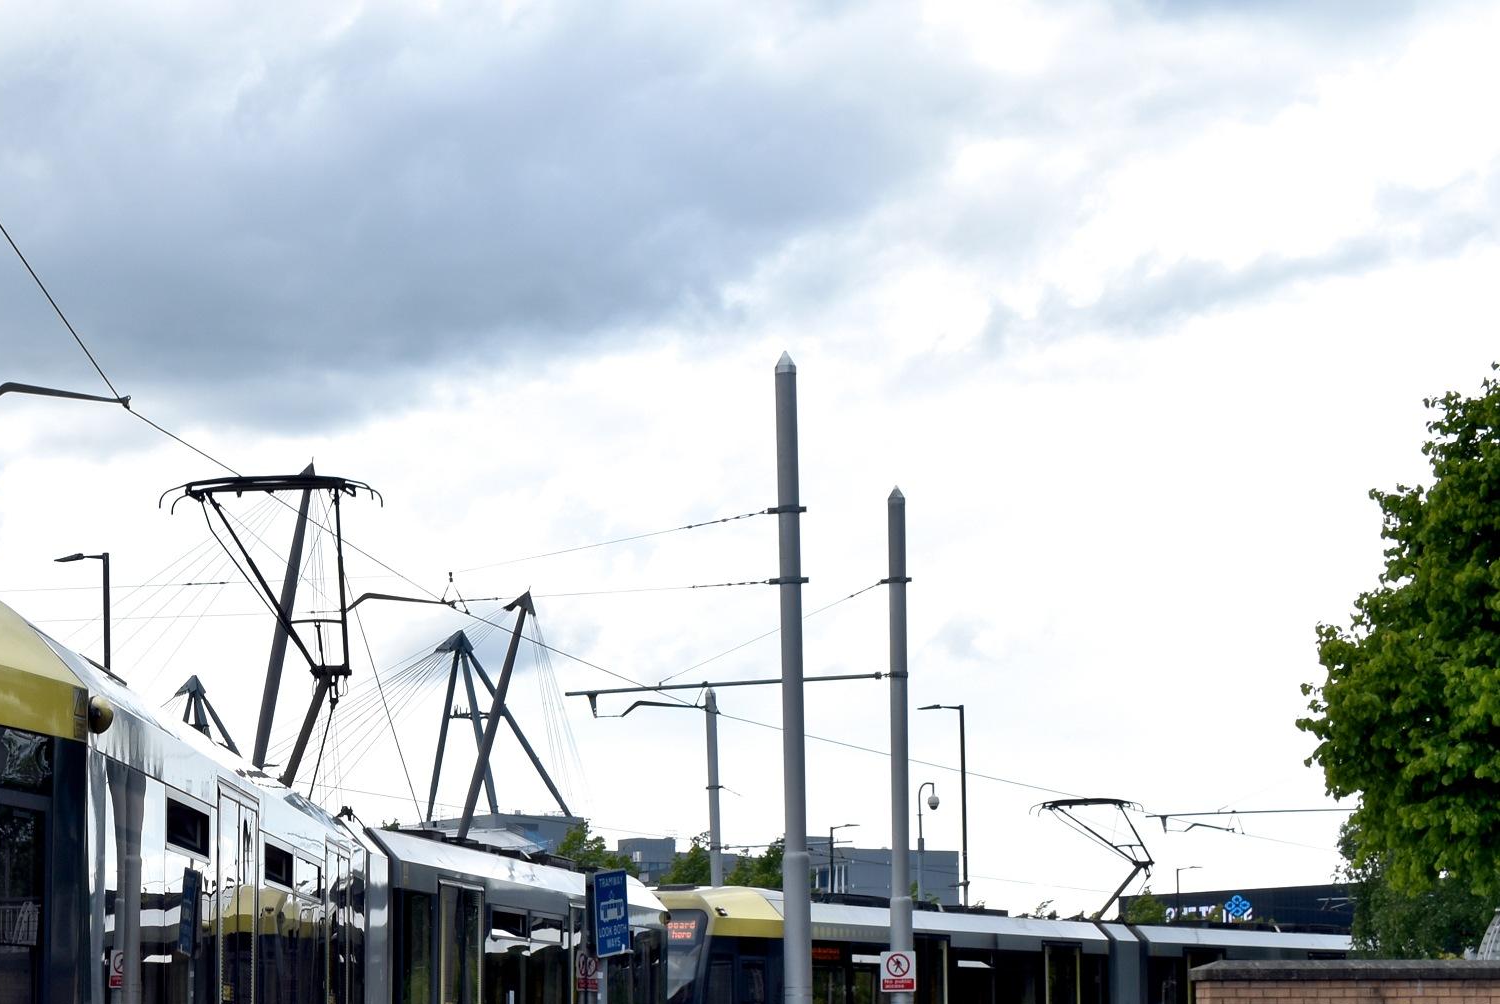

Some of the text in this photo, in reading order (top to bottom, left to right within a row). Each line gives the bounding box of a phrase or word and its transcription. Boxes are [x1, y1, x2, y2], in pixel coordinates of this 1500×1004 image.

[598, 876, 623, 888] TRAMWAY
[599, 923, 628, 938] LOOK BOTH
[606, 937, 621, 948] WAYS
